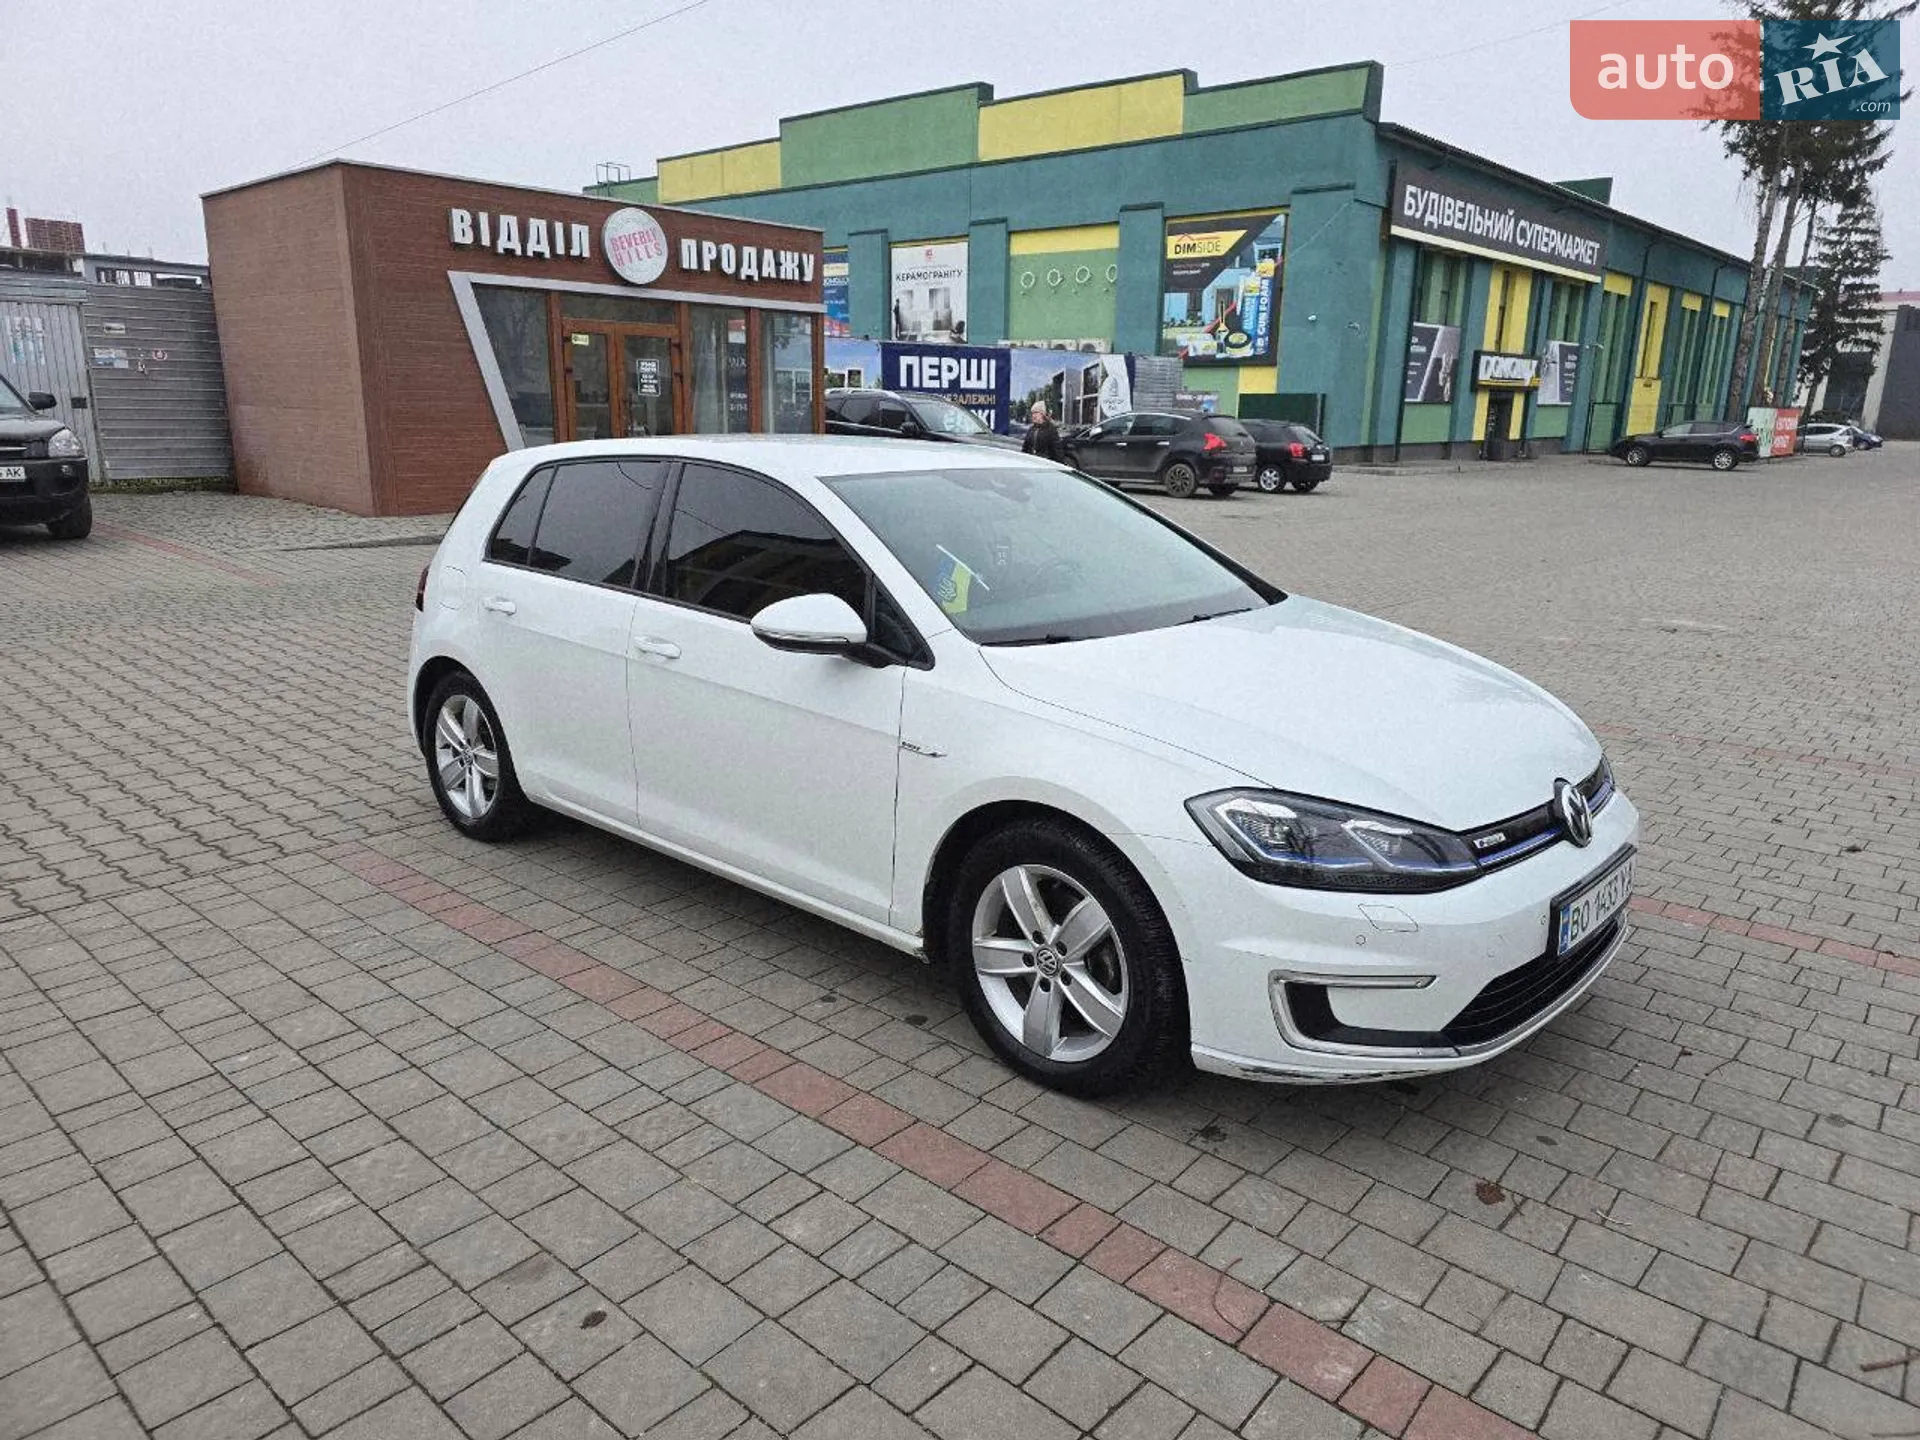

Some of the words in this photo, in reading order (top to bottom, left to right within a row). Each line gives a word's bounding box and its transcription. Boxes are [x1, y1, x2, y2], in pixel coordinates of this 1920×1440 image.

[1403, 184, 1516, 243] БУДІВЕЛЬНИЙ
[1515, 219, 1601, 266] СУПЕРМАРКЕТ
[450, 207, 591, 260] ВІДДІЛ
[680, 238, 815, 282] ПРОДАЖУ
[610, 228, 658, 252] BEVERLY
[1174, 240, 1222, 256] DIMSIDE
[613, 241, 663, 267] HILLS
[896, 269, 963, 282] КЕРАМОГРАНІТУ
[899, 355, 997, 390] ПЕРШІ
